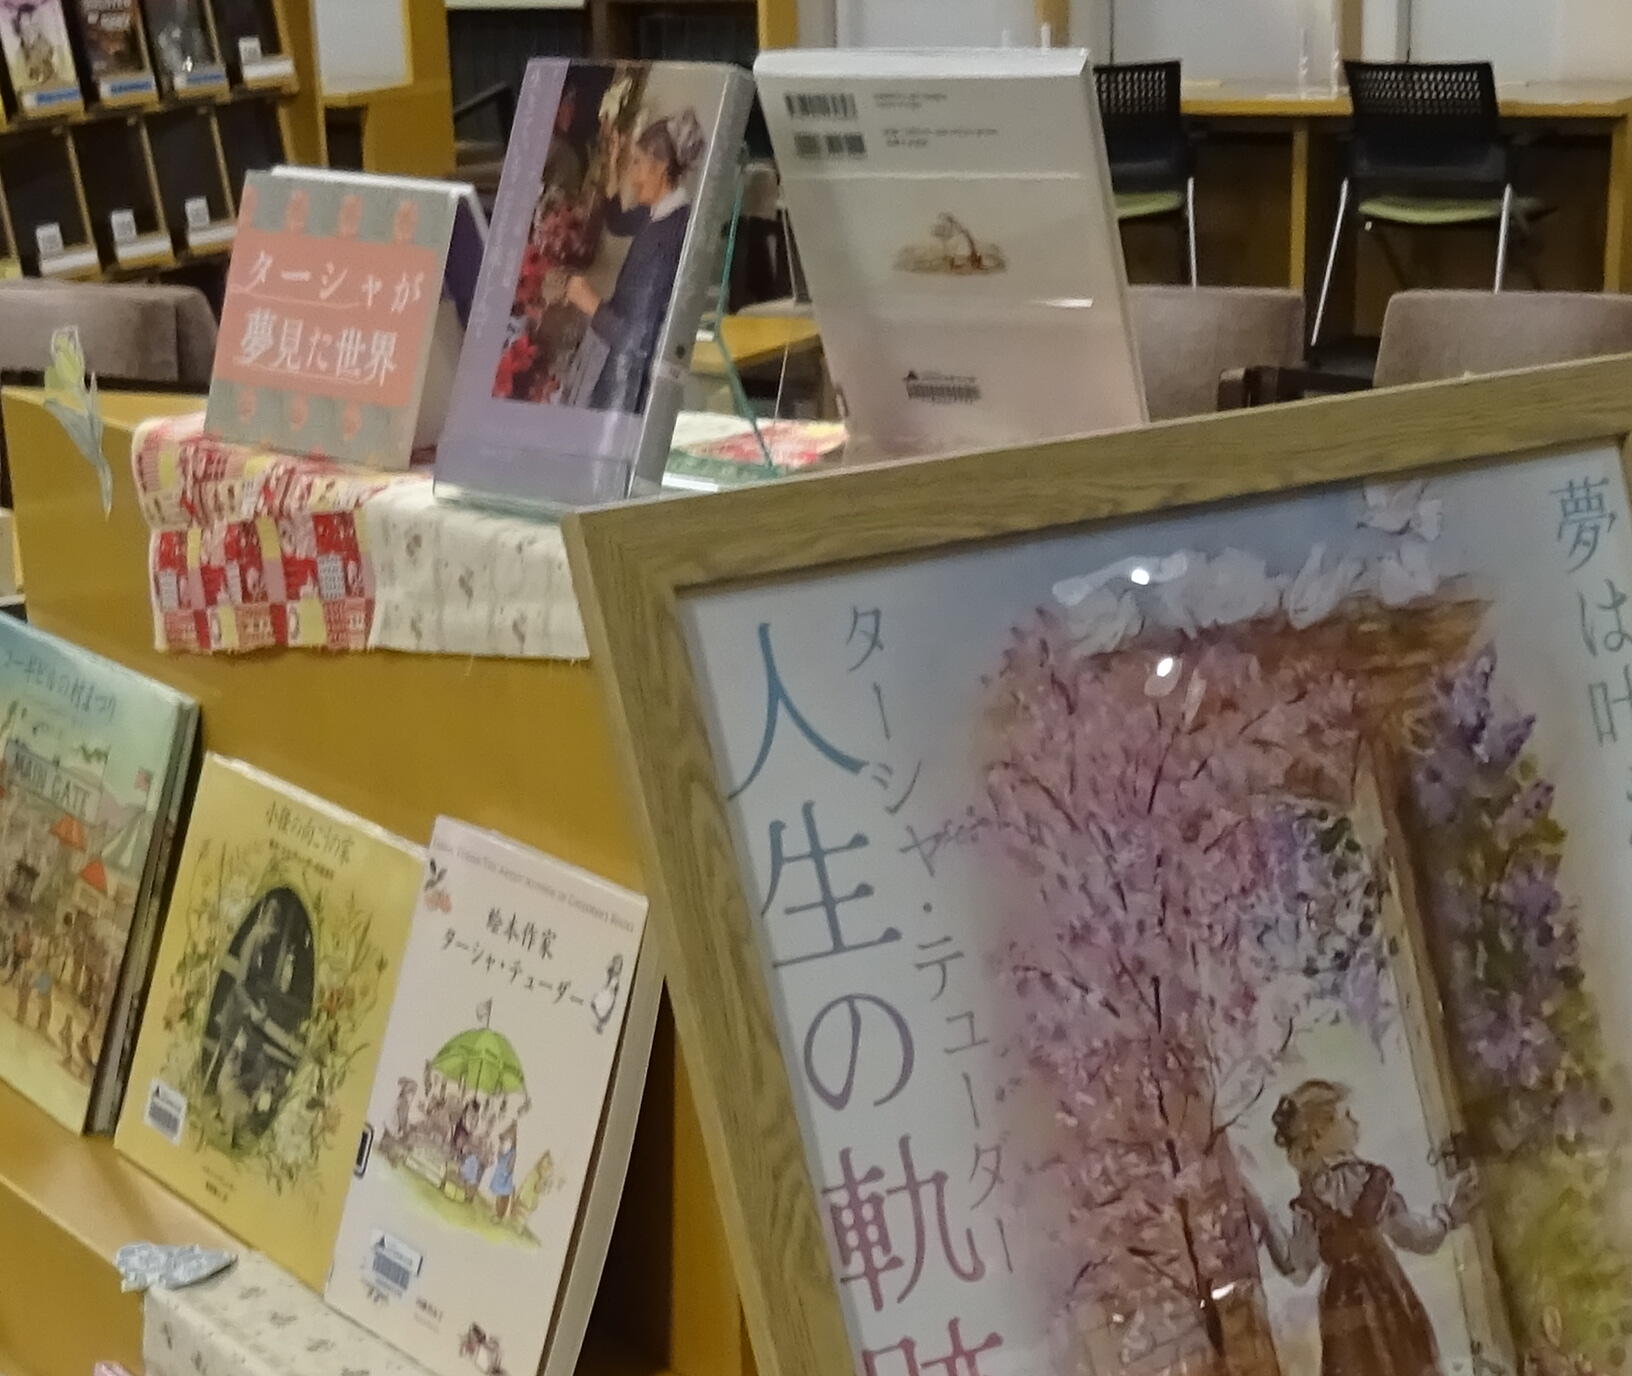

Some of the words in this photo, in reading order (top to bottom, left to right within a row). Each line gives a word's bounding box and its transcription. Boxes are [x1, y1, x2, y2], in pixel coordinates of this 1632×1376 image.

[245, 250, 425, 315] ターシャが
[234, 307, 398, 387] 夢見た世界
[440, 927, 585, 1008] ターシャ・テューダー
[486, 906, 558, 962] 絵本作家
[845, 606, 1015, 1273] ターシャ・テューダー
